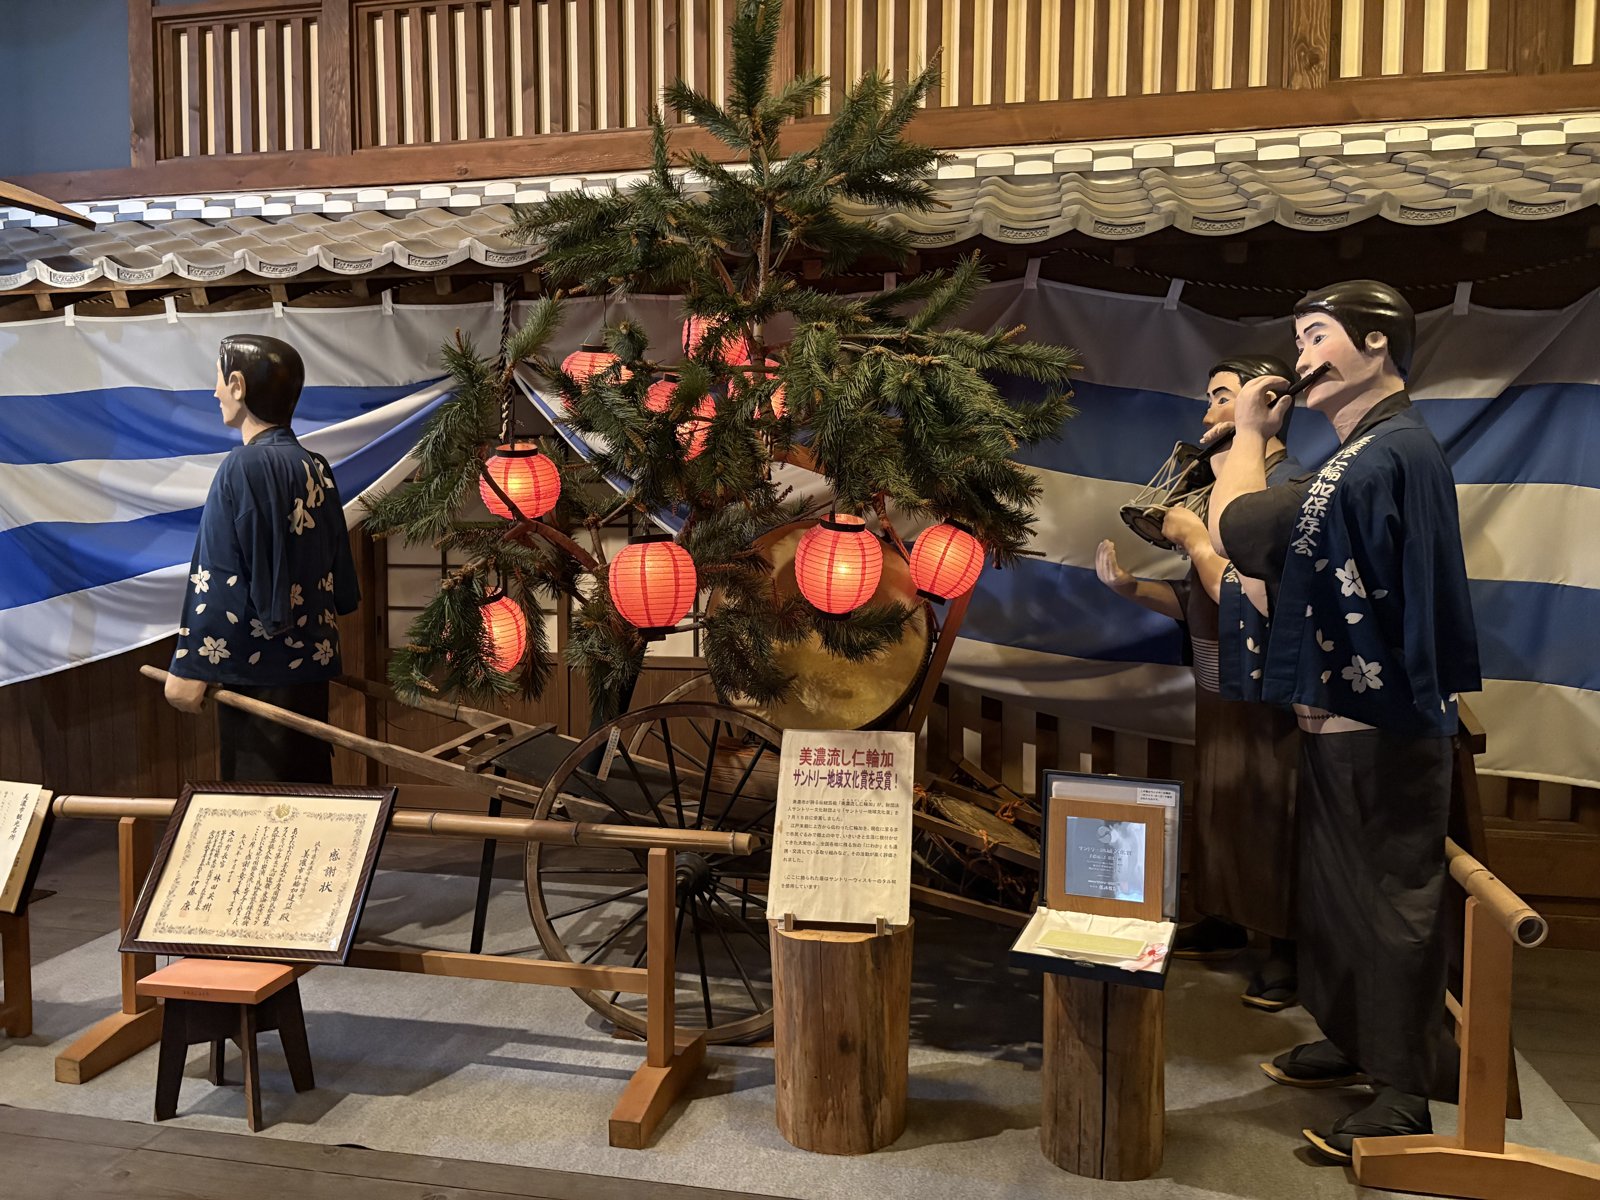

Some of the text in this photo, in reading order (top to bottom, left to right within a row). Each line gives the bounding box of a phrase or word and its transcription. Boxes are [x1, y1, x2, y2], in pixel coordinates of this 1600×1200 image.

[799, 747, 894, 768] 美濃流し仁輪加
[793, 768, 898, 791] サントリー地域文化賞を受賞！
[318, 848, 341, 893] 感謝状
